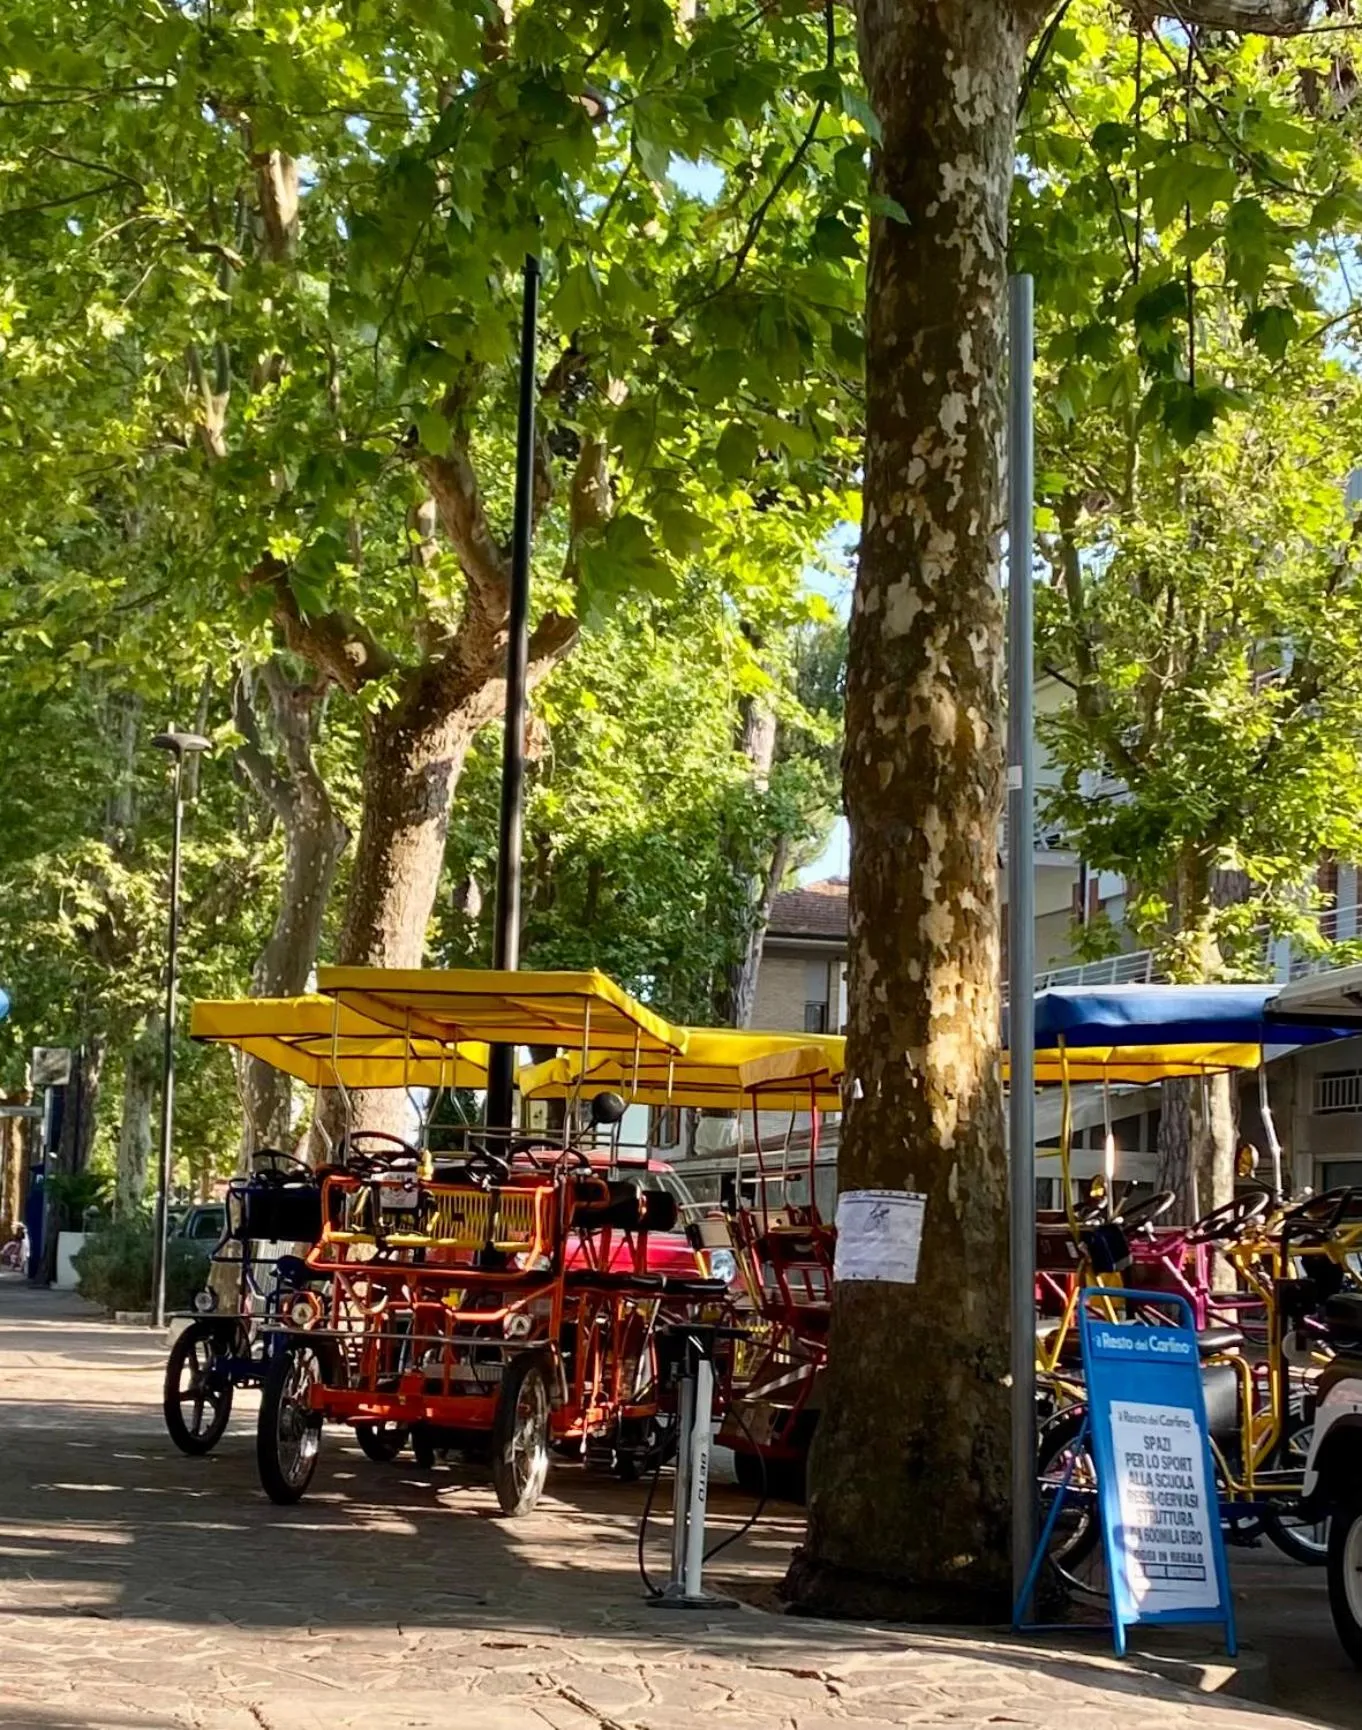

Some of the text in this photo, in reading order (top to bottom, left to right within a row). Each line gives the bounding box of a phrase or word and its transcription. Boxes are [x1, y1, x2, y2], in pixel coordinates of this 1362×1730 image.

[1102, 1332, 1134, 1350] Resto
[1134, 1340, 1149, 1351] del
[1149, 1335, 1191, 1354] Carlino
[1124, 1411, 1147, 1424] Resto
[1159, 1414, 1191, 1428] Carlino
[1143, 1435, 1172, 1452] SPAZI
[1125, 1452, 1193, 1472] PER LO SPORT
[1128, 1470, 1195, 1490] ALLA SCUOLA
[1136, 1508, 1195, 1527] STRUTTURA
[1181, 1531, 1203, 1546] EURO
[1158, 1551, 1168, 1562] IN
[1169, 1552, 1204, 1564] REGALO
